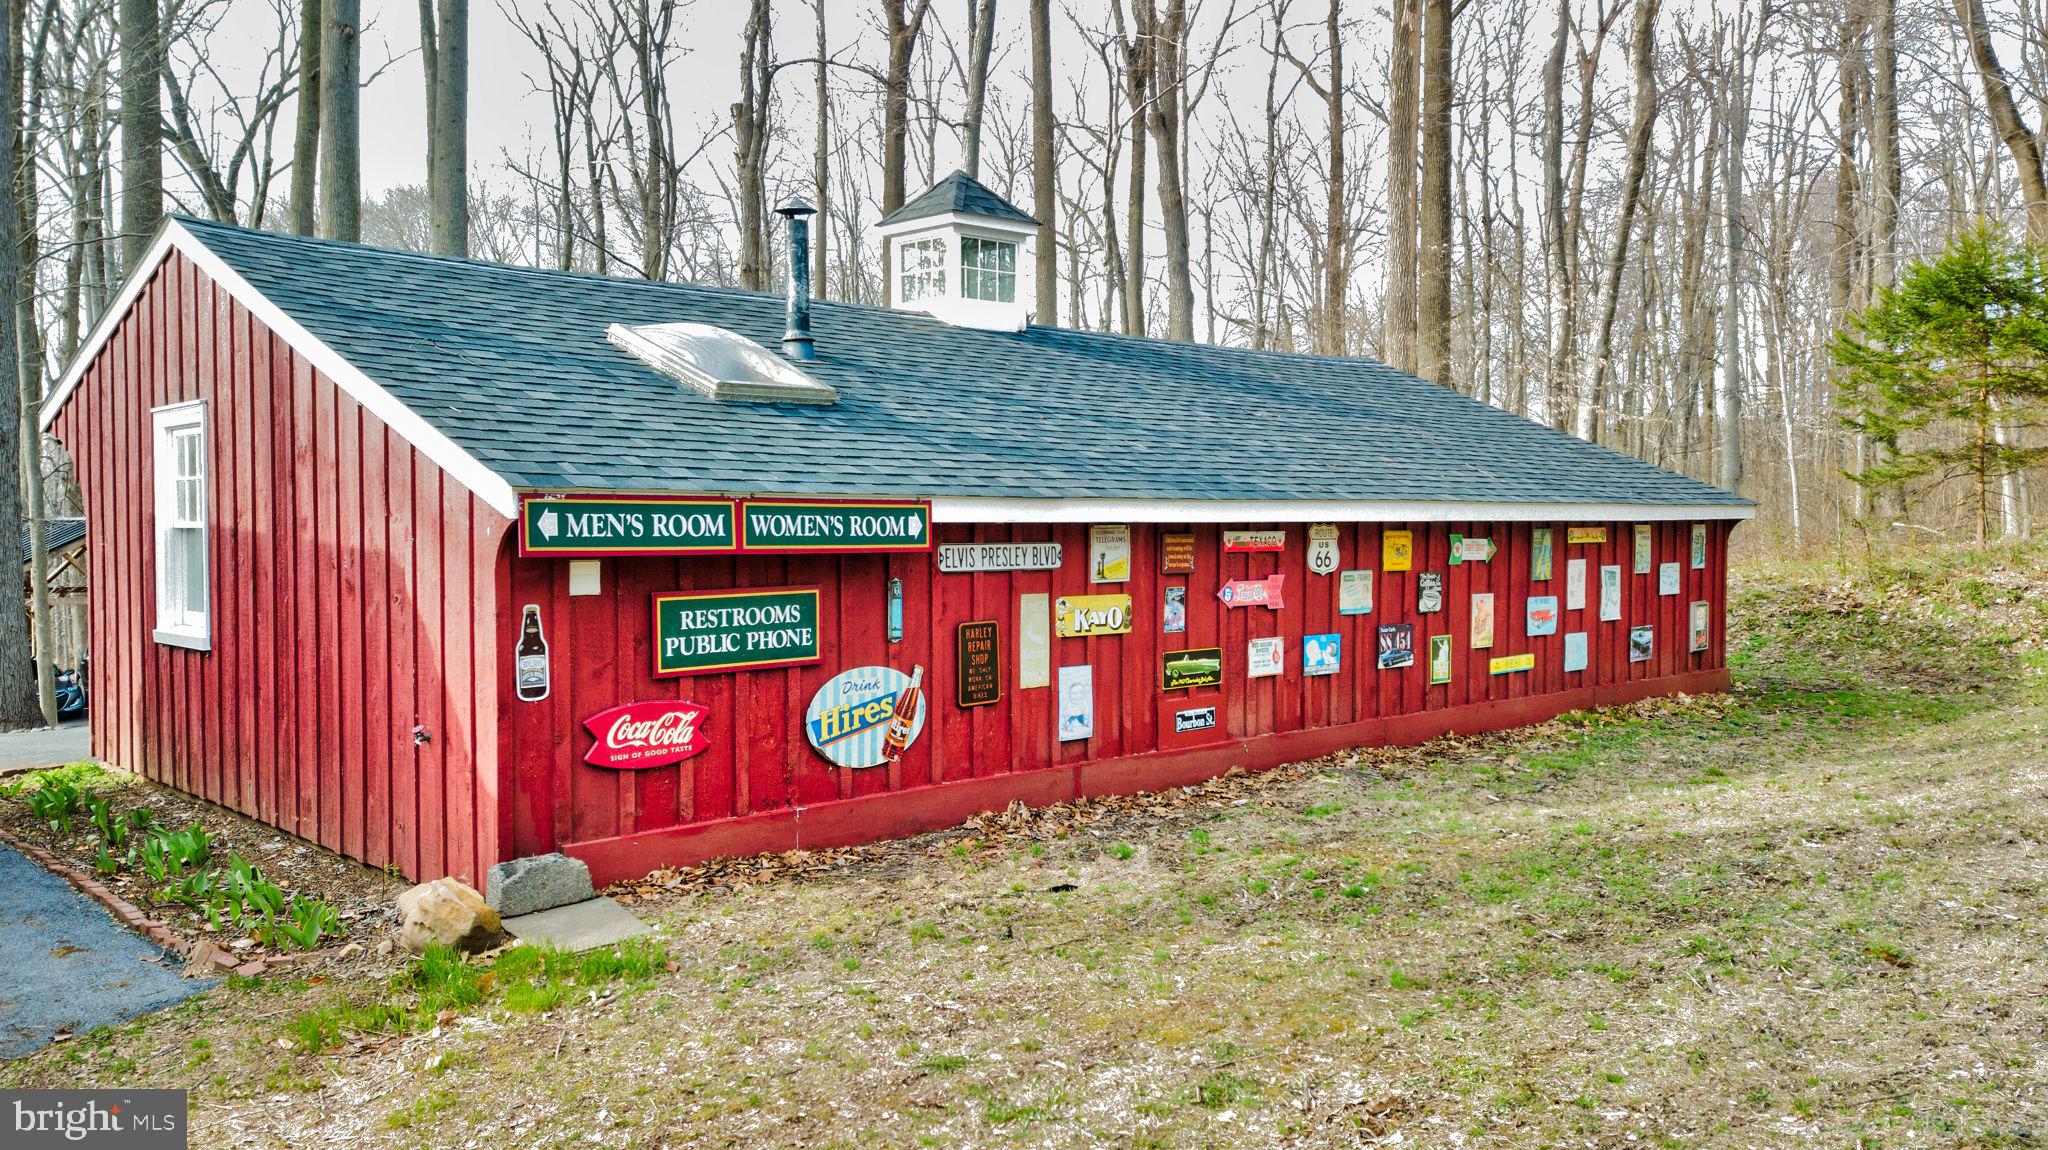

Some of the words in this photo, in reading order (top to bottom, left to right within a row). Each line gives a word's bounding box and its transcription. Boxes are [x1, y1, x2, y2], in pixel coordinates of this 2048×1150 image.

[566, 512, 643, 539] MEN'S
[652, 512, 726, 538] ROOM
[750, 512, 844, 538] WOMEN'S
[849, 512, 906, 537] ROOM
[1315, 528, 1334, 537] ROUTE
[1318, 541, 1330, 549] US
[945, 547, 976, 569] ELVIS
[981, 546, 1029, 567] PRESLEY
[1032, 545, 1057, 566] BLVD
[1315, 551, 1332, 568] 66
[679, 604, 801, 631] RESTROOMS
[965, 626, 992, 639] HARLEY
[665, 632, 741, 657] PUBLIC
[745, 627, 813, 653] PHONE
[967, 639, 991, 652] REPAIR
[971, 653, 989, 665] SHOP
[842, 678, 881, 695] Drink
[968, 684, 993, 692] AMERICAN
[817, 694, 895, 744] Hires
[1177, 714, 1205, 730] Bourbon
[606, 711, 699, 749] Coca-Cola
[610, 754, 629, 762] SIGN
[631, 752, 642, 760] OF
[644, 749, 668, 757] GOOD
